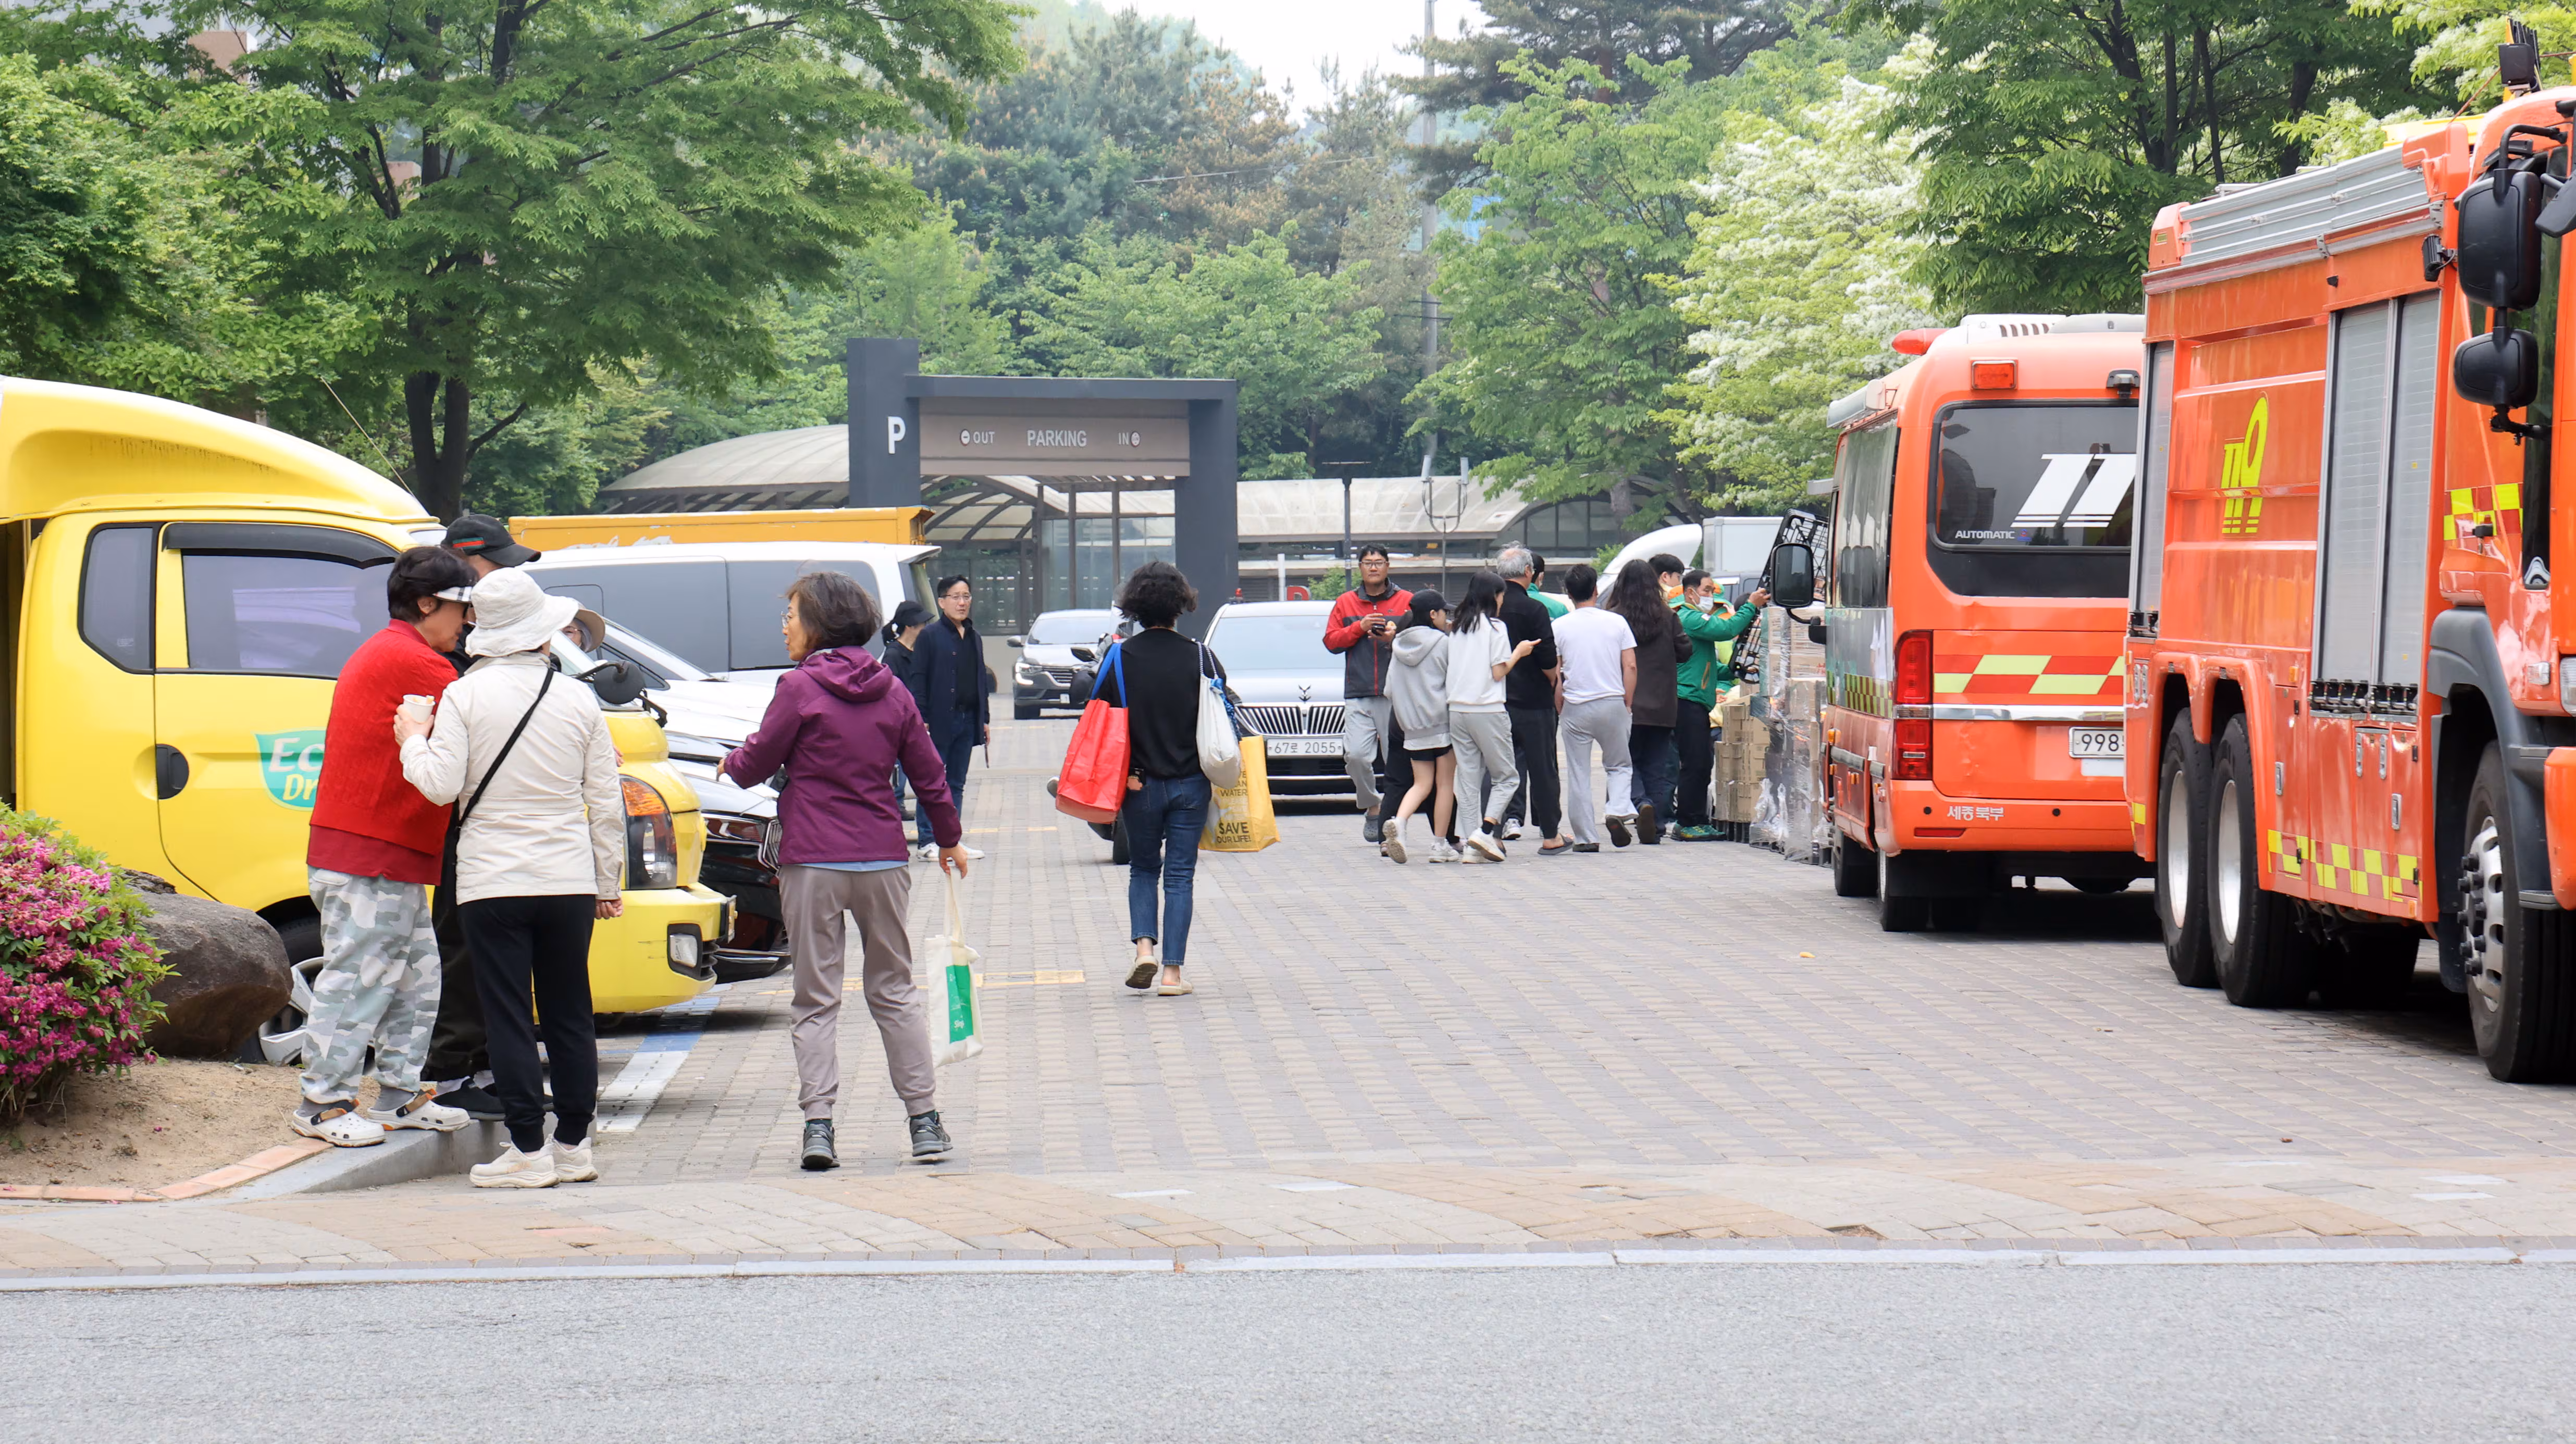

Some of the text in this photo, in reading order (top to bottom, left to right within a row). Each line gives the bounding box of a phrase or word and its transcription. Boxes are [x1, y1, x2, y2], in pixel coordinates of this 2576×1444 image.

[887, 416, 906, 454] P
[973, 431, 995, 444] OUT
[1027, 429, 1087, 447] PARKING
[1118, 432, 1129, 445] IN
[2010, 453, 2137, 528] 11
[1955, 530, 2015, 539] AUTOMATIC
[1274, 742, 1336, 754] 67로 2055
[2081, 733, 2124, 752] 998
[268, 737, 326, 773] Ec
[282, 774, 319, 801] Dr
[1218, 821, 1249, 835] SAVE
